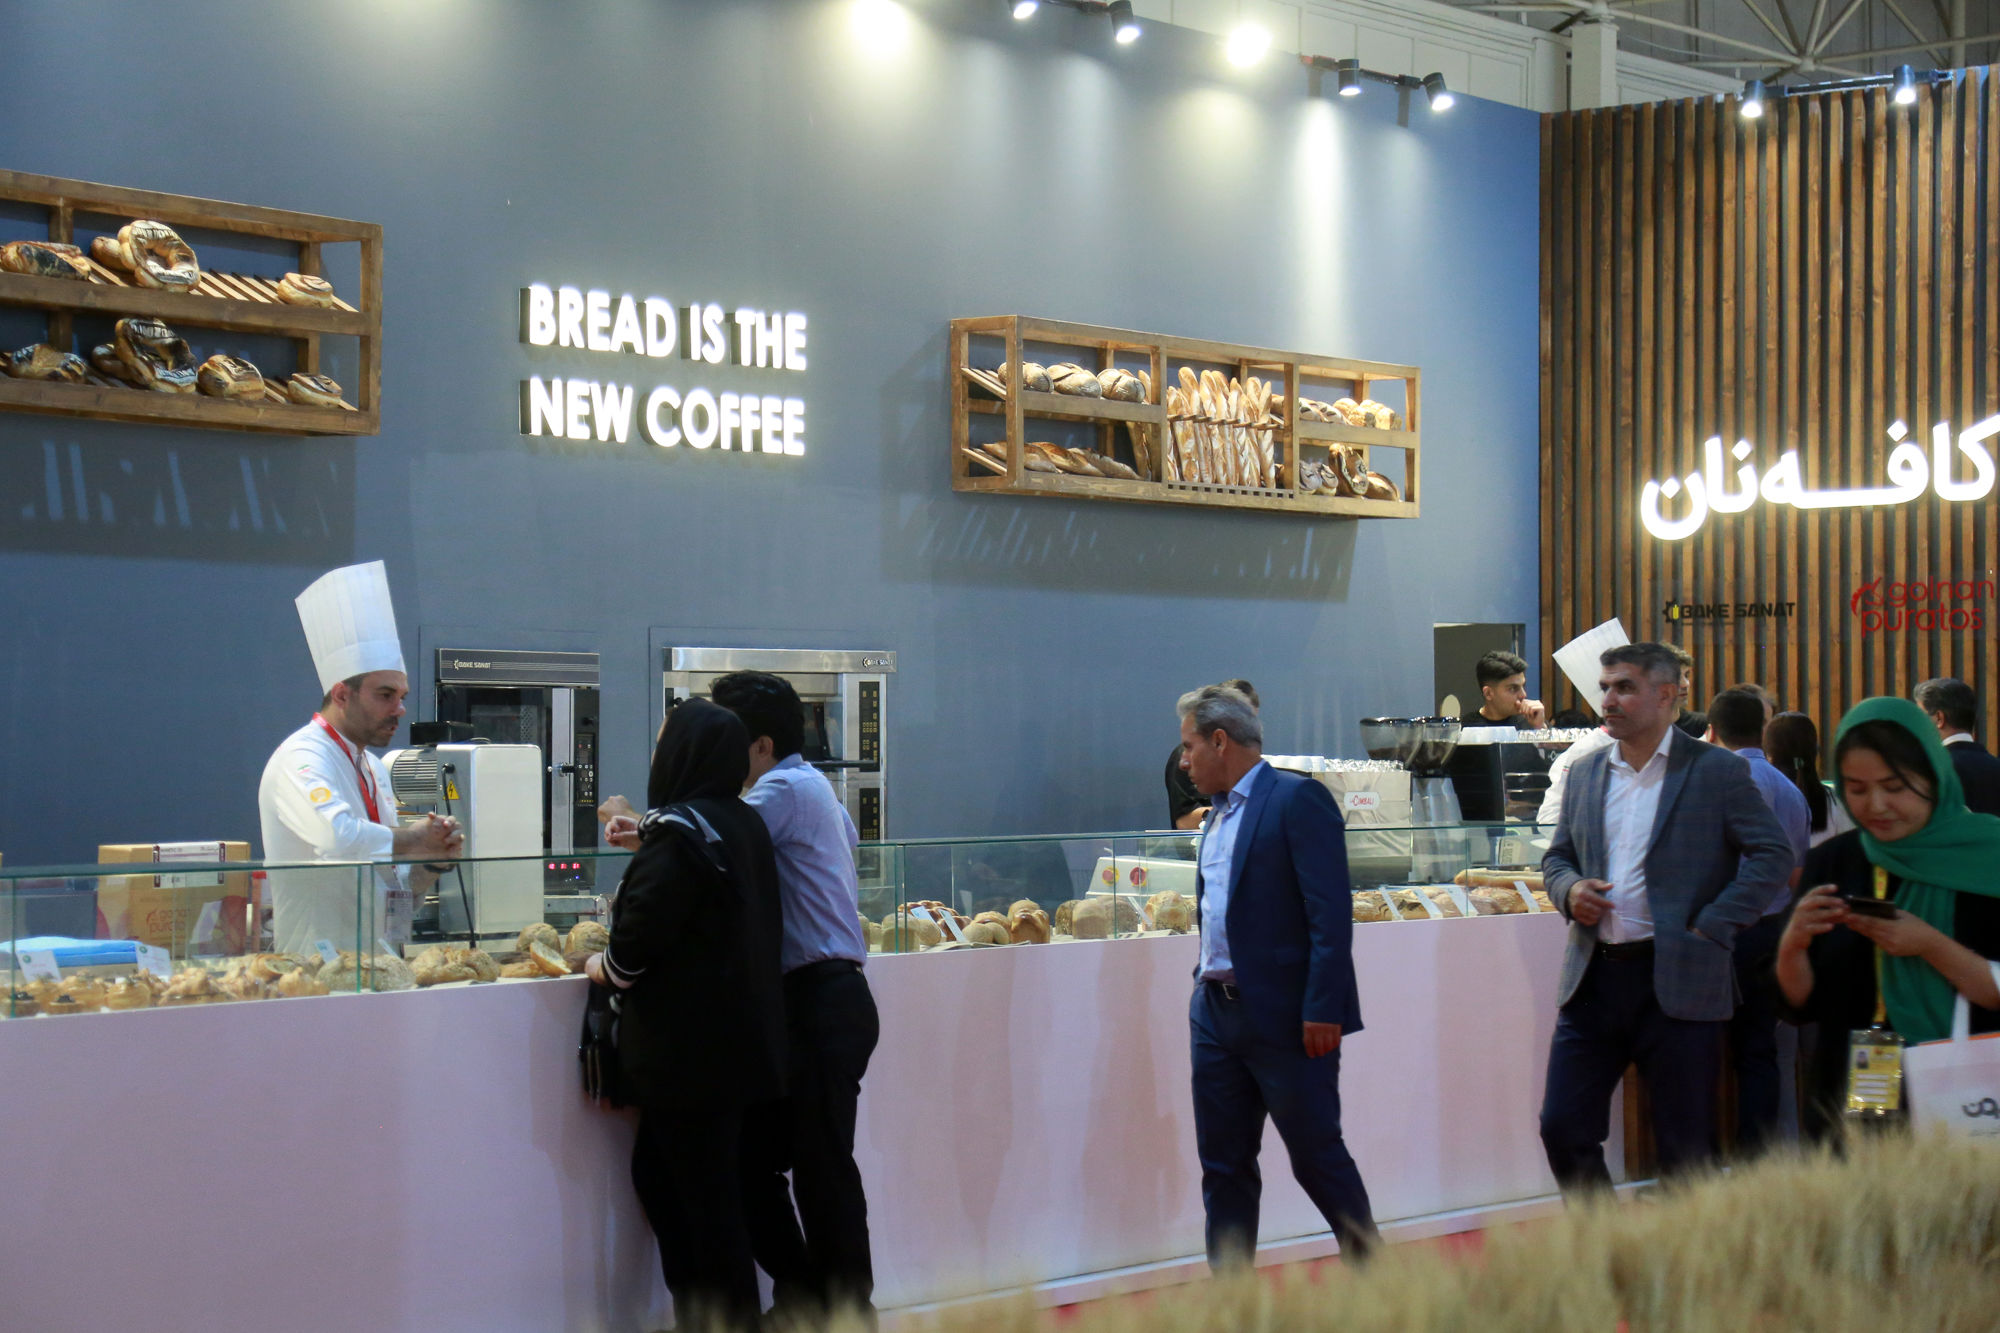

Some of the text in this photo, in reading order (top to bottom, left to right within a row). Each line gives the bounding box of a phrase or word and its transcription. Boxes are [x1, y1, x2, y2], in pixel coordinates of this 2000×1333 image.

[520, 283, 808, 371] BREAD IS THE
[520, 376, 805, 456] NEW COFFEE
[1680, 602, 1796, 619] BAKE SANAT
[1888, 576, 1995, 608] golnan
[1861, 601, 1984, 638] puratos
